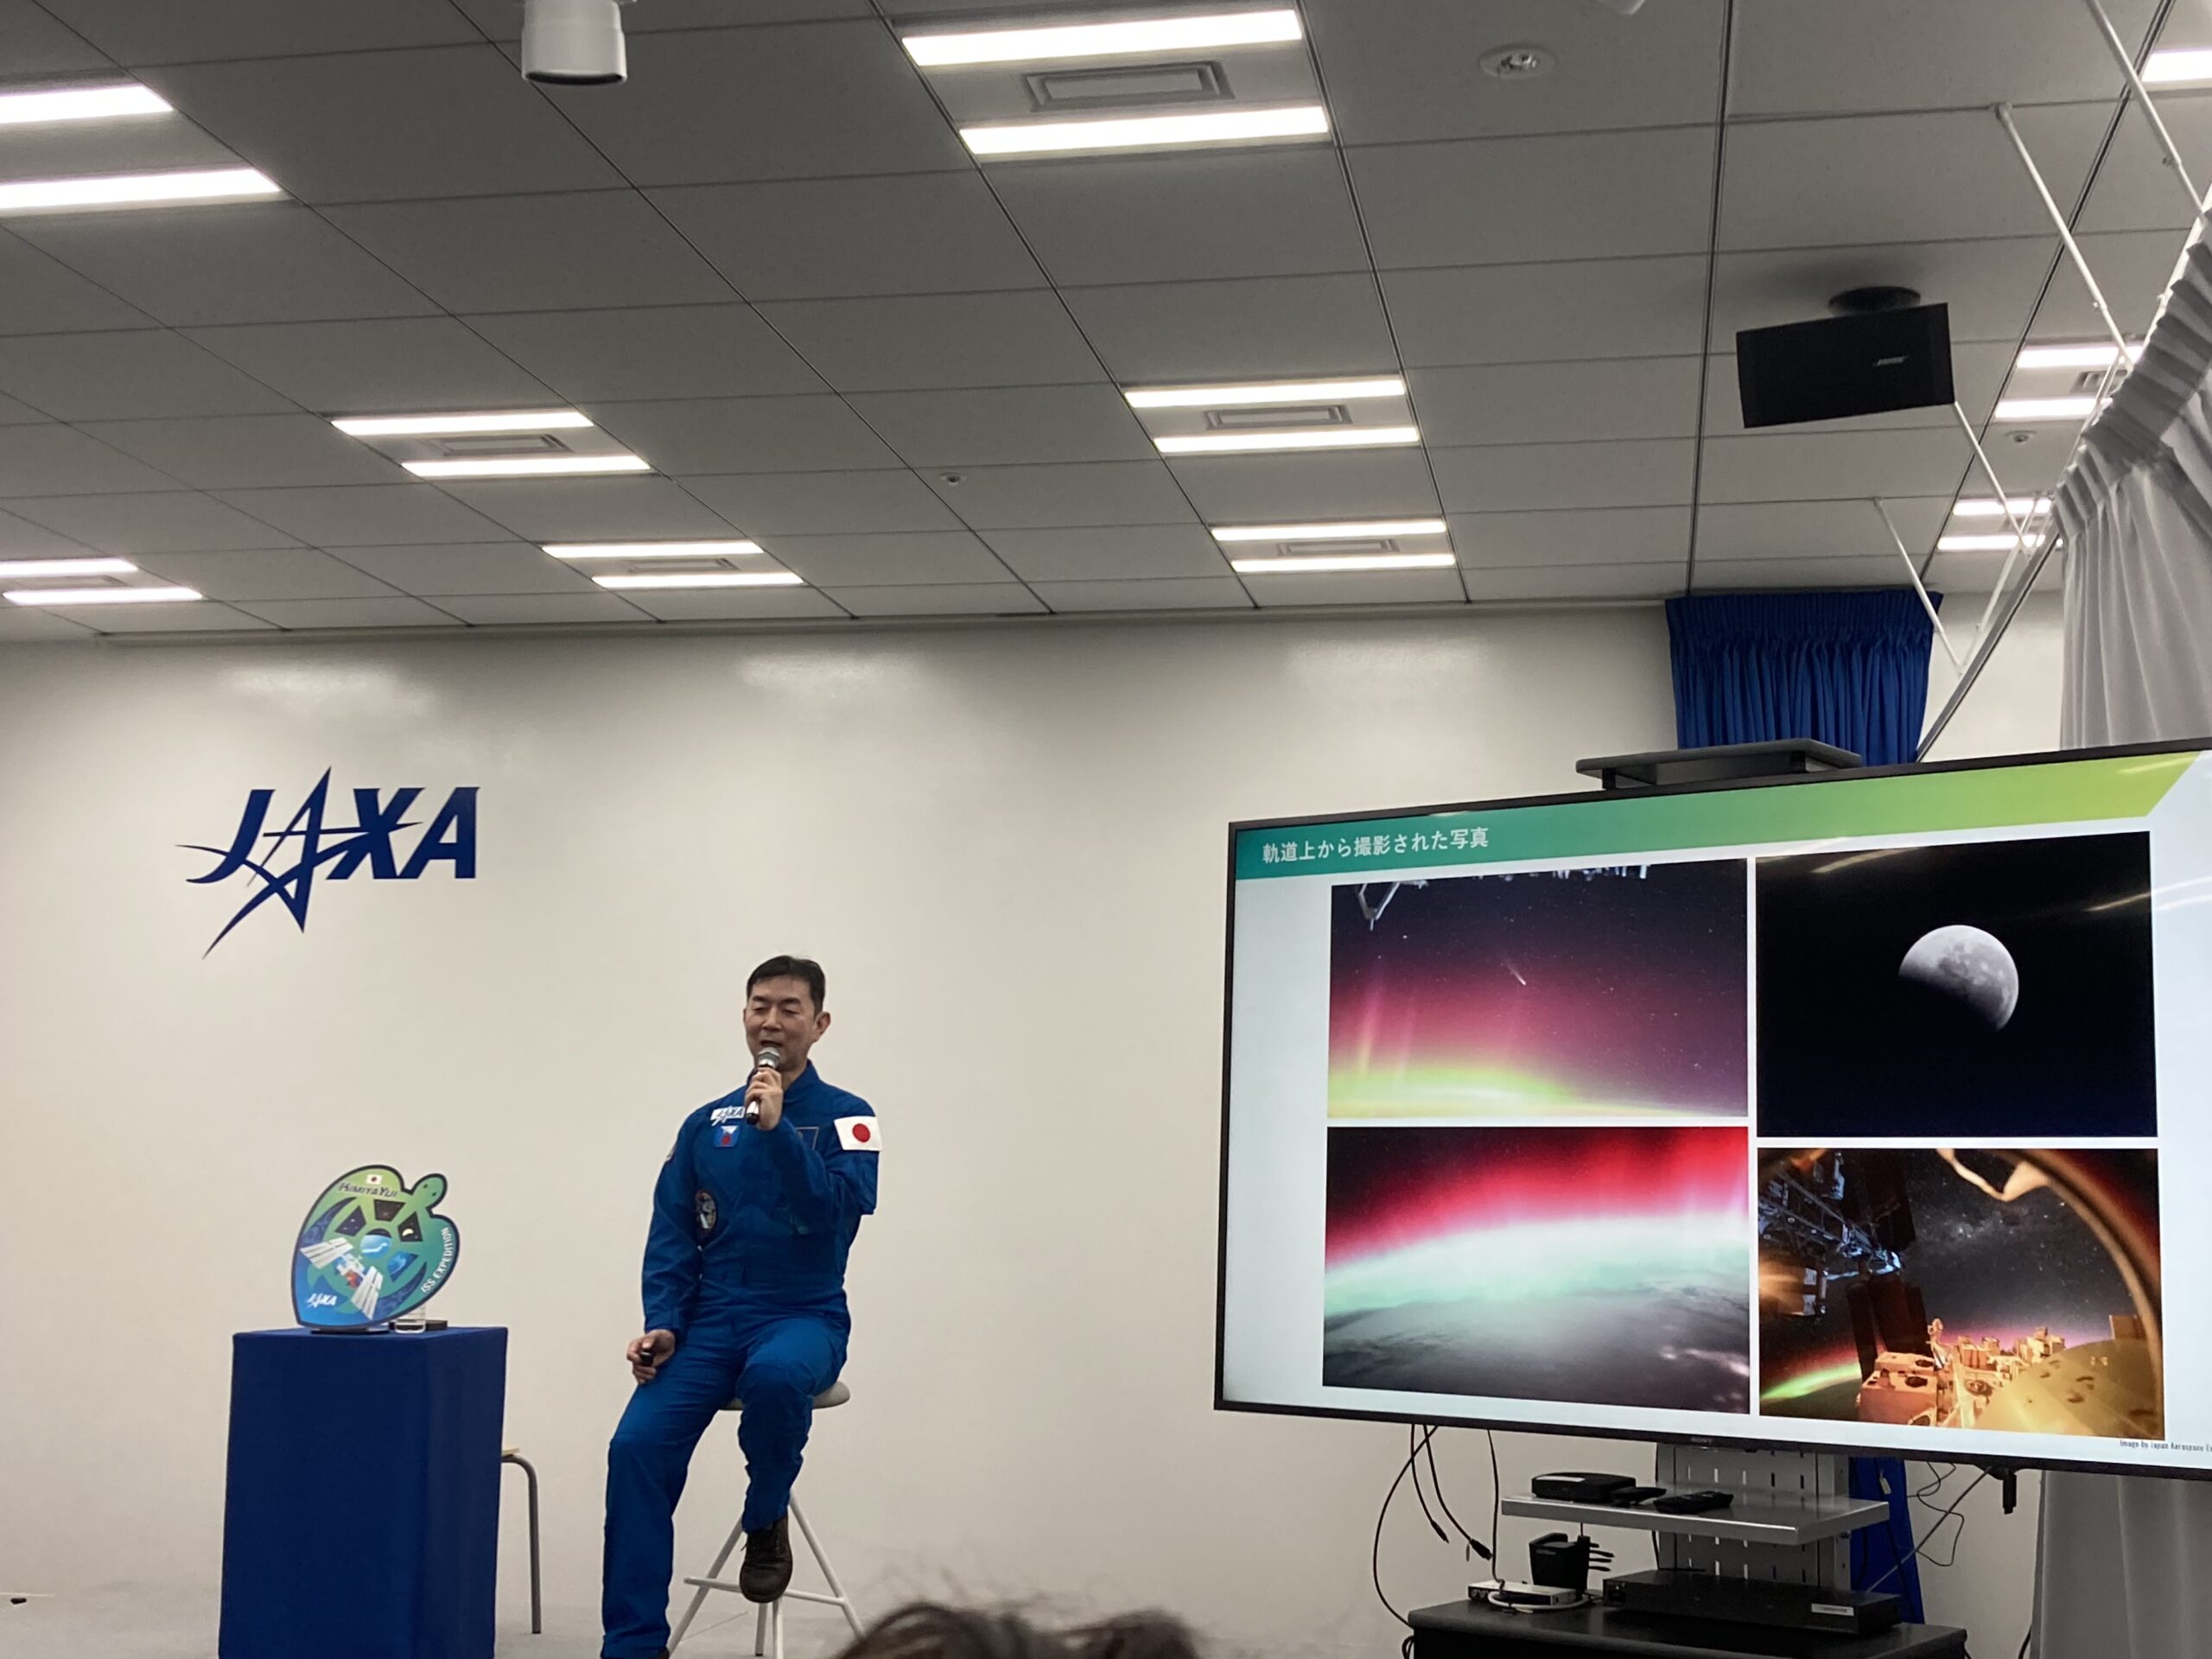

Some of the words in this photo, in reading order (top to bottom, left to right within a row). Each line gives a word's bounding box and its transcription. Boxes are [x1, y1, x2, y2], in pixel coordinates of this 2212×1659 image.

[175, 766, 481, 960] JAXA
[1262, 826, 1490, 864] 軌道上から撮影された写真
[307, 1293, 337, 1308] JAXA
